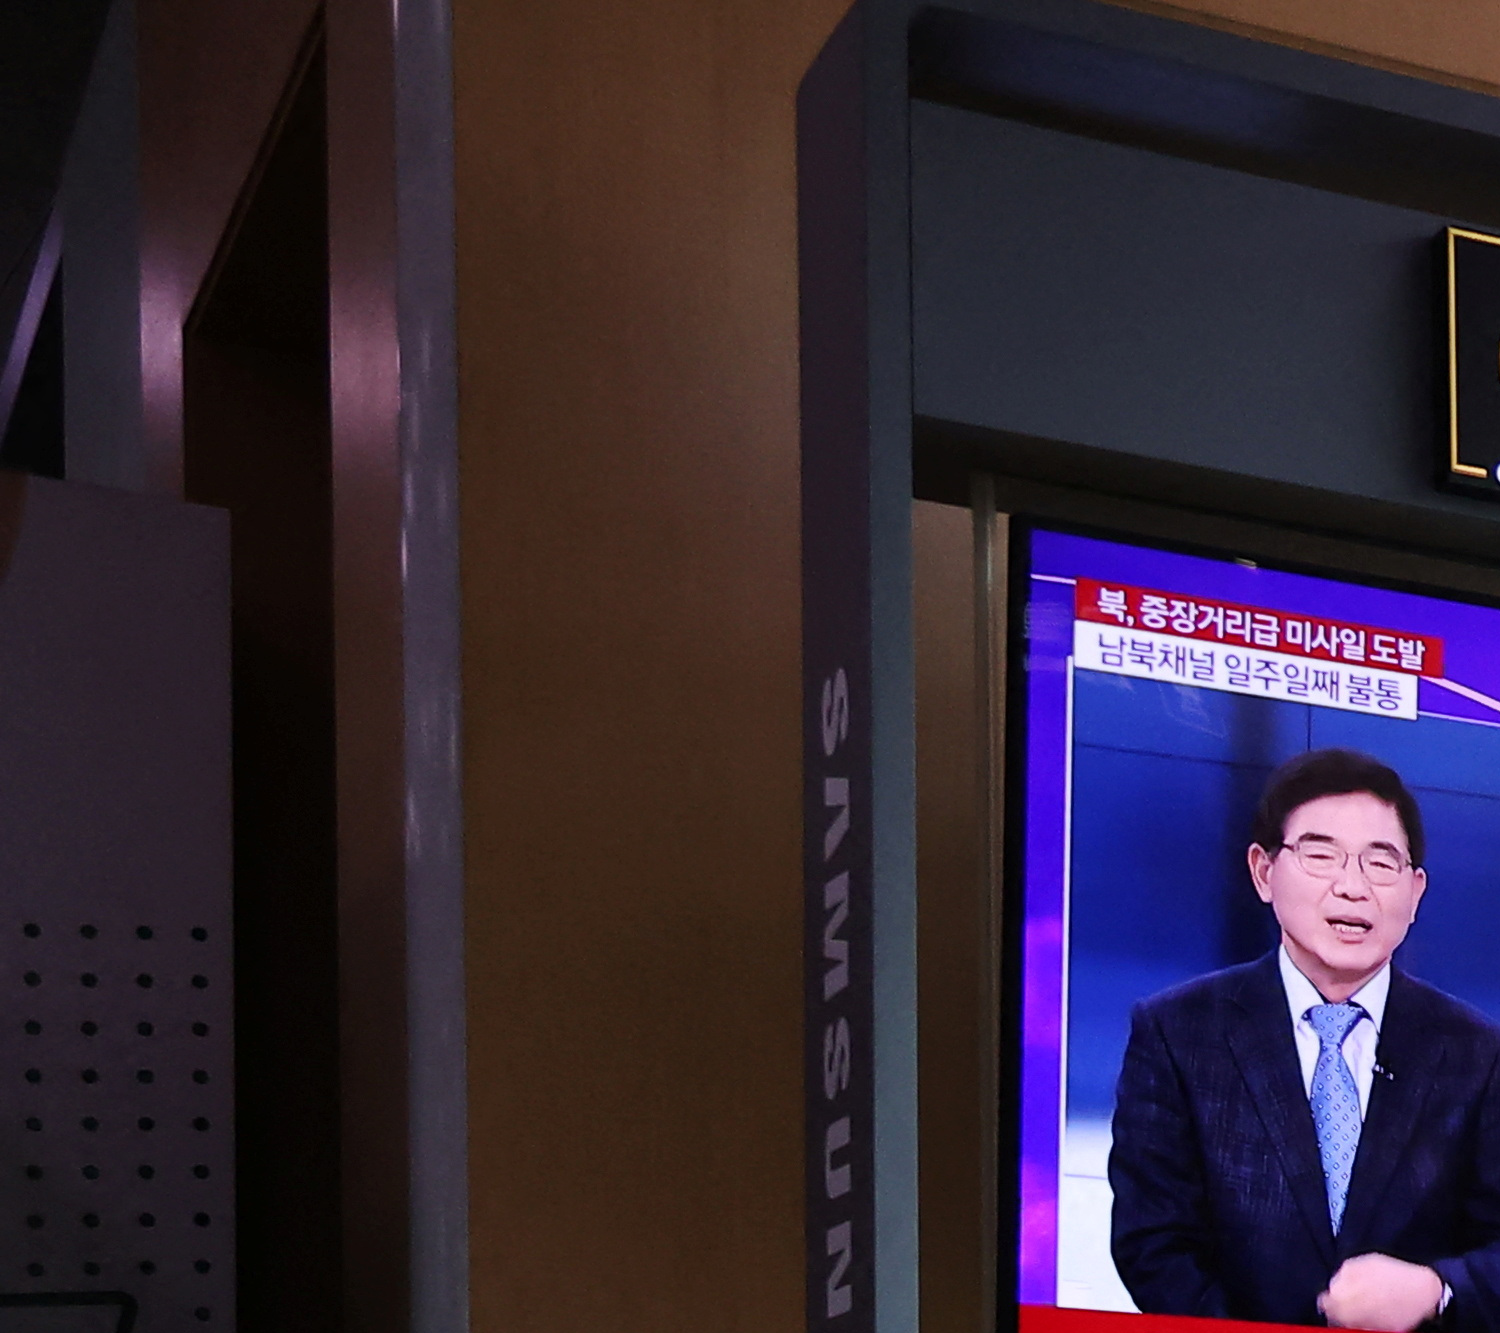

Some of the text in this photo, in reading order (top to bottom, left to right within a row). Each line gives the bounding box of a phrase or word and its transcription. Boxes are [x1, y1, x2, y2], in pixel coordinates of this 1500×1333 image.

[1096, 587, 1426, 672] 북, 중장거리급 미사일 도발
[1098, 632, 1404, 713] 남북채널 일주일째 불통
